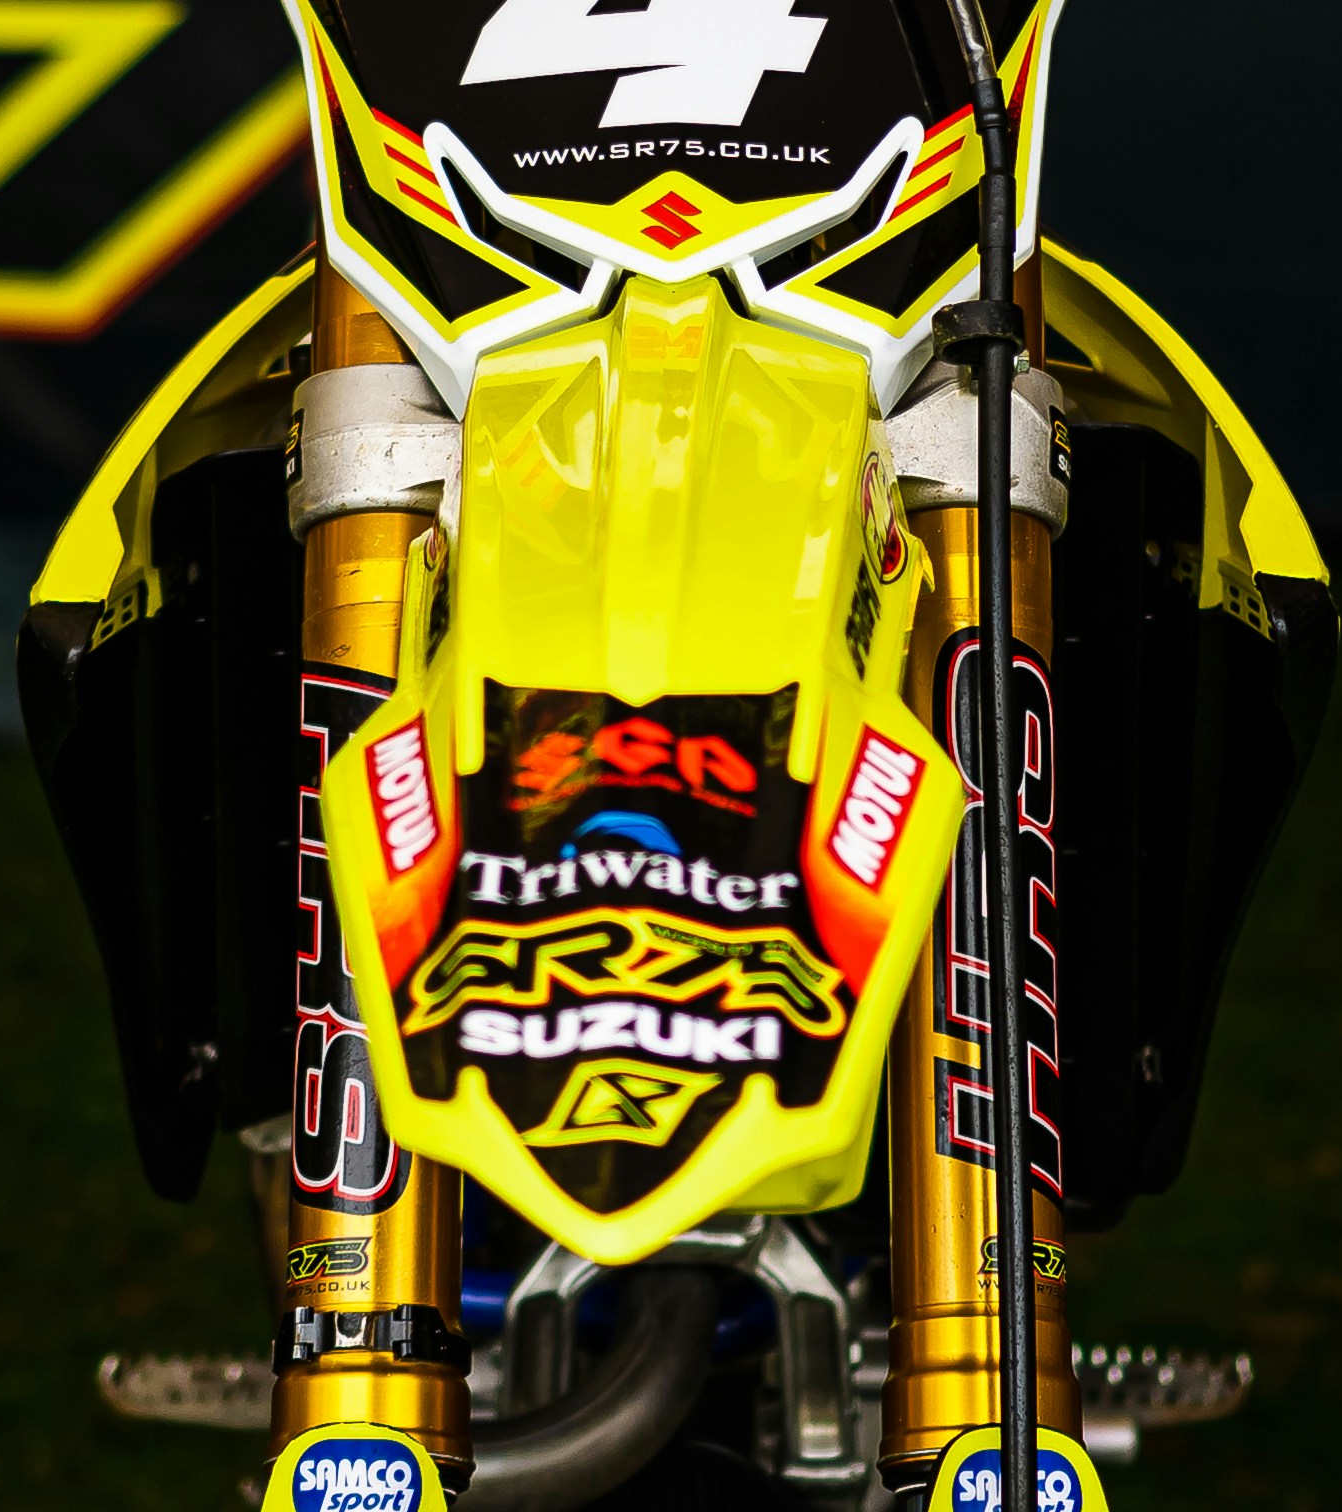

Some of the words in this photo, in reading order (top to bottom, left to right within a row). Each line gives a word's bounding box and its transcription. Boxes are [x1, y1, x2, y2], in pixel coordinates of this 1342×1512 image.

[513, 140, 832, 169] WWW.SR75.CO.UK
[371, 726, 439, 873] MOTUL
[831, 738, 917, 885] MOTUL
[462, 850, 799, 911] Triwater
[459, 1001, 781, 1062] SUZUKI
[299, 1458, 413, 1492] SAMCO
